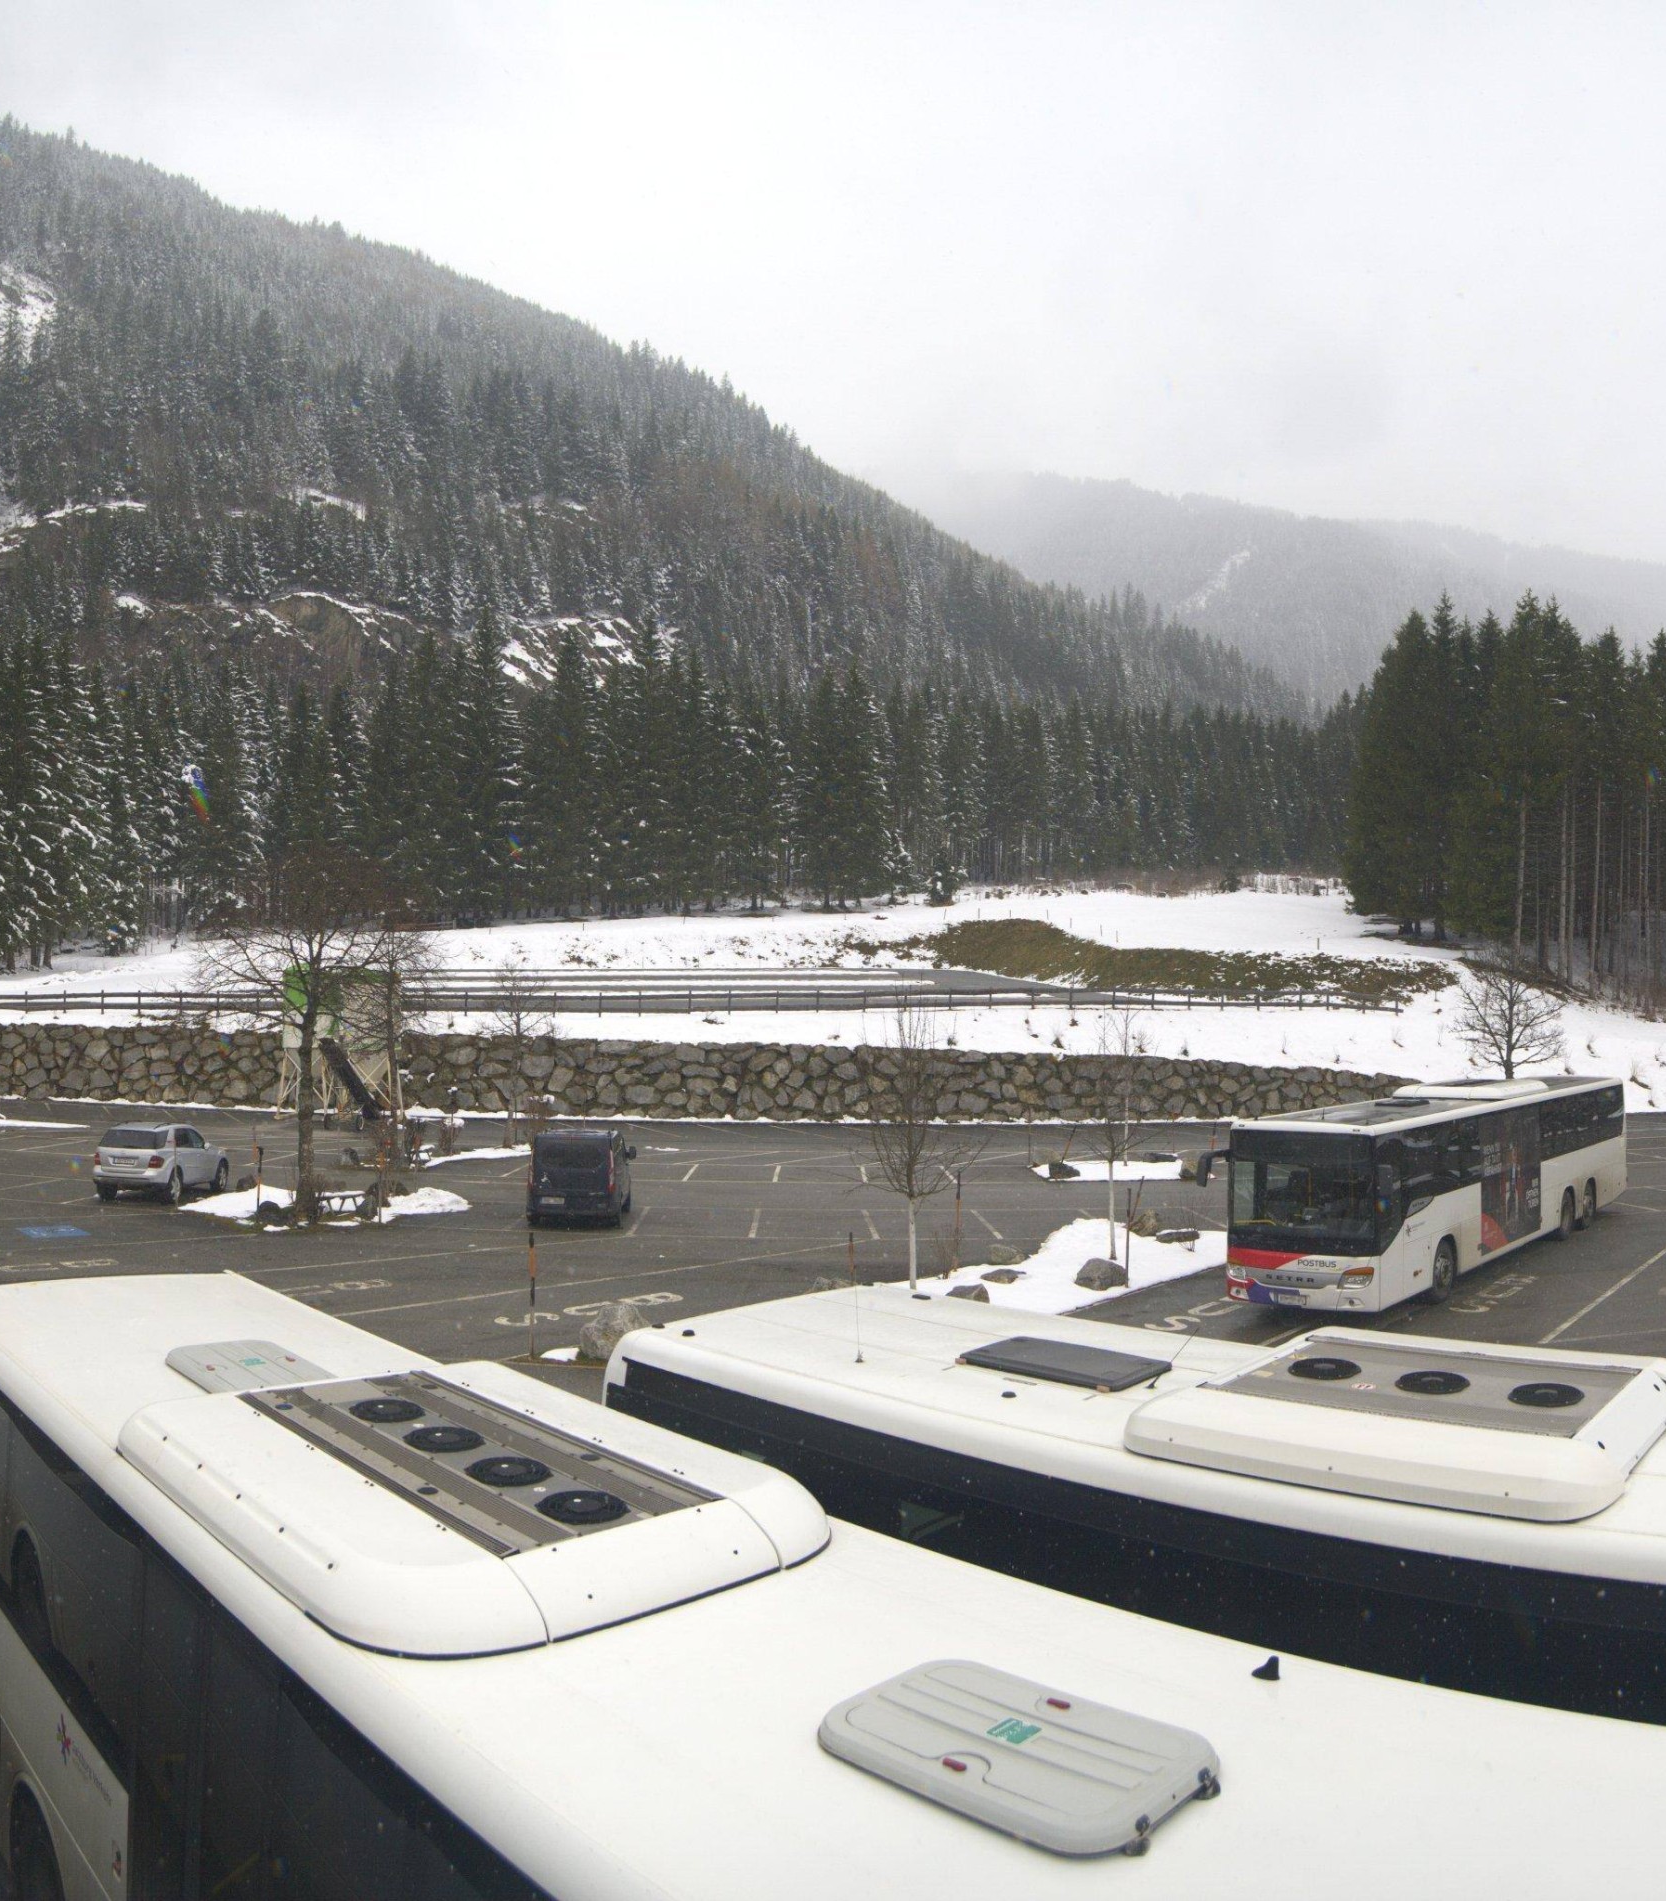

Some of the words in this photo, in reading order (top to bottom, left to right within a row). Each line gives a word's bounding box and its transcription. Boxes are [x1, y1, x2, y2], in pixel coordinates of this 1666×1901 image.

[1297, 1259, 1337, 1268] POSTBUS
[1265, 1274, 1315, 1283] SETRA
[494, 1291, 684, 1327] BUS
